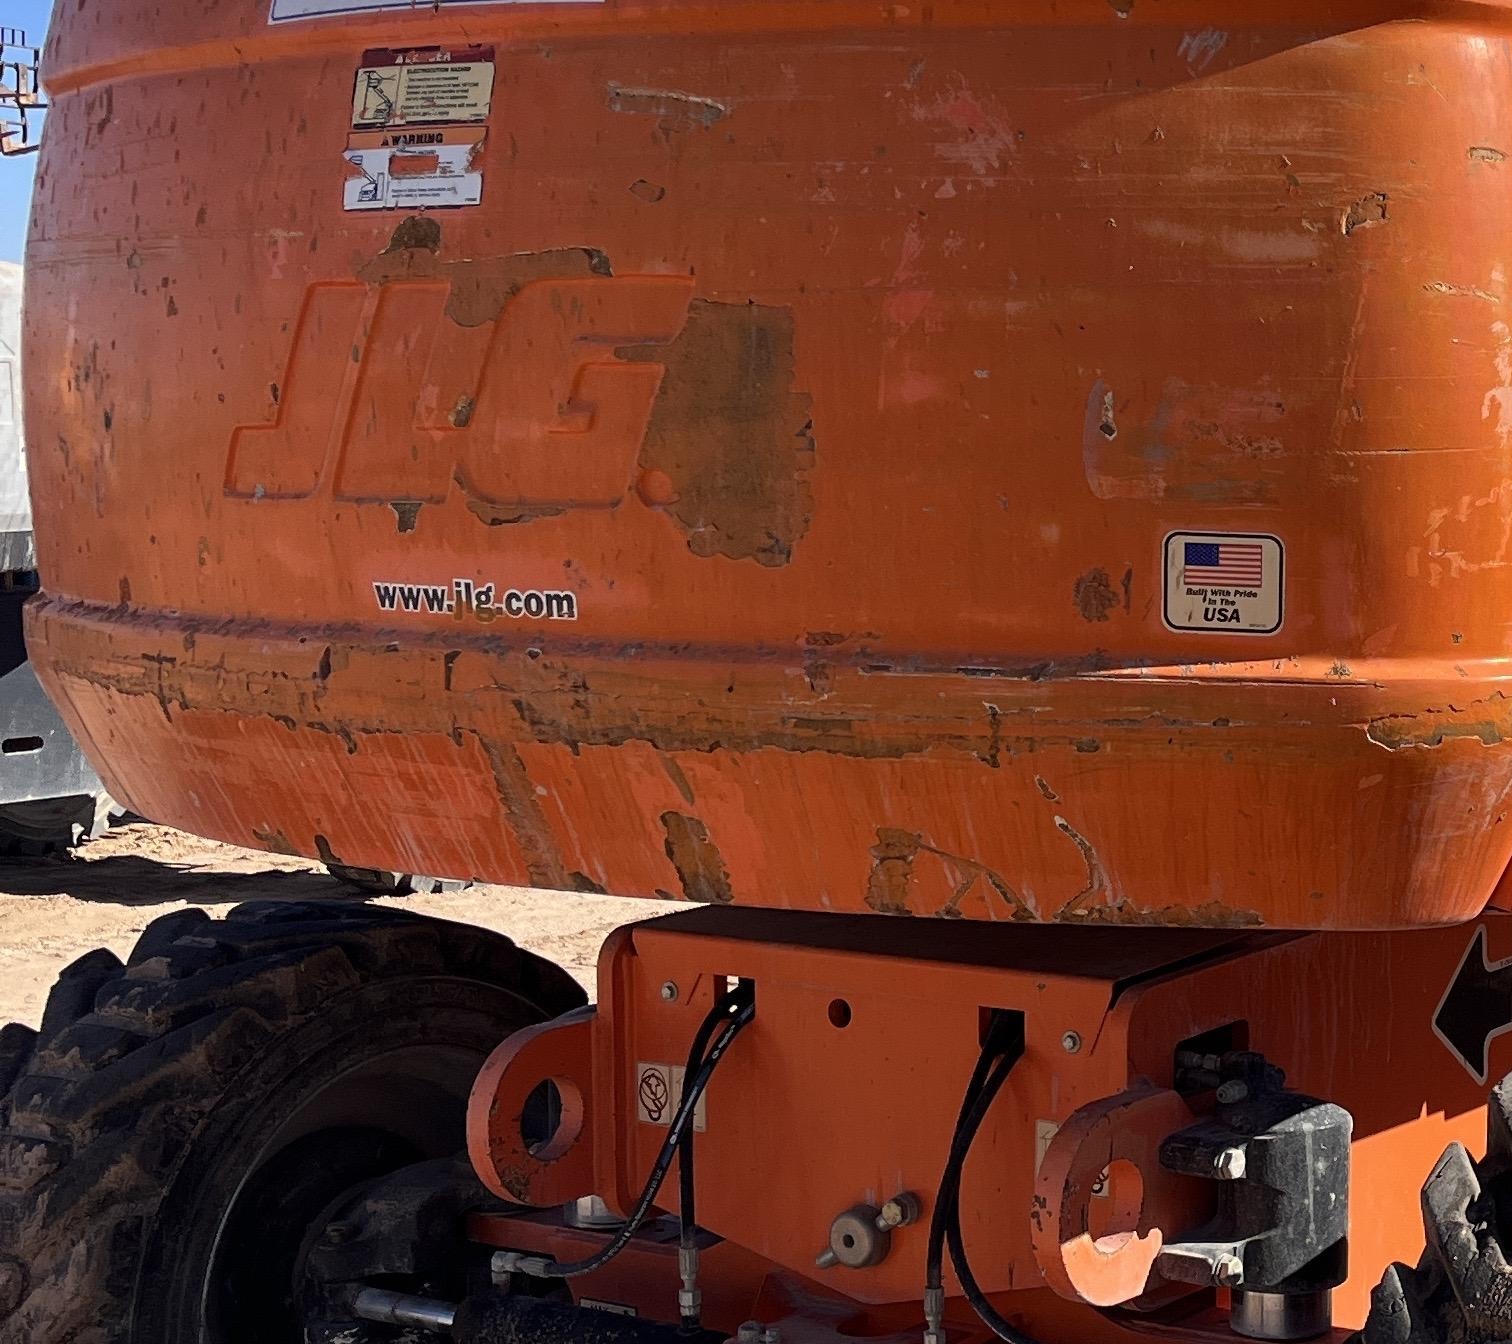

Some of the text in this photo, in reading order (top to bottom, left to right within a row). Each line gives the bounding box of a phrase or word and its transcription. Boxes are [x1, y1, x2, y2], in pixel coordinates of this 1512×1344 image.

[391, 133, 443, 146] WARNING
[224, 273, 697, 513] JLG
[1210, 588, 1232, 598] With
[1233, 589, 1258, 599] Pride
[373, 581, 575, 622] www.jlg.com
[1219, 598, 1237, 607] The
[1202, 607, 1241, 624] USA
